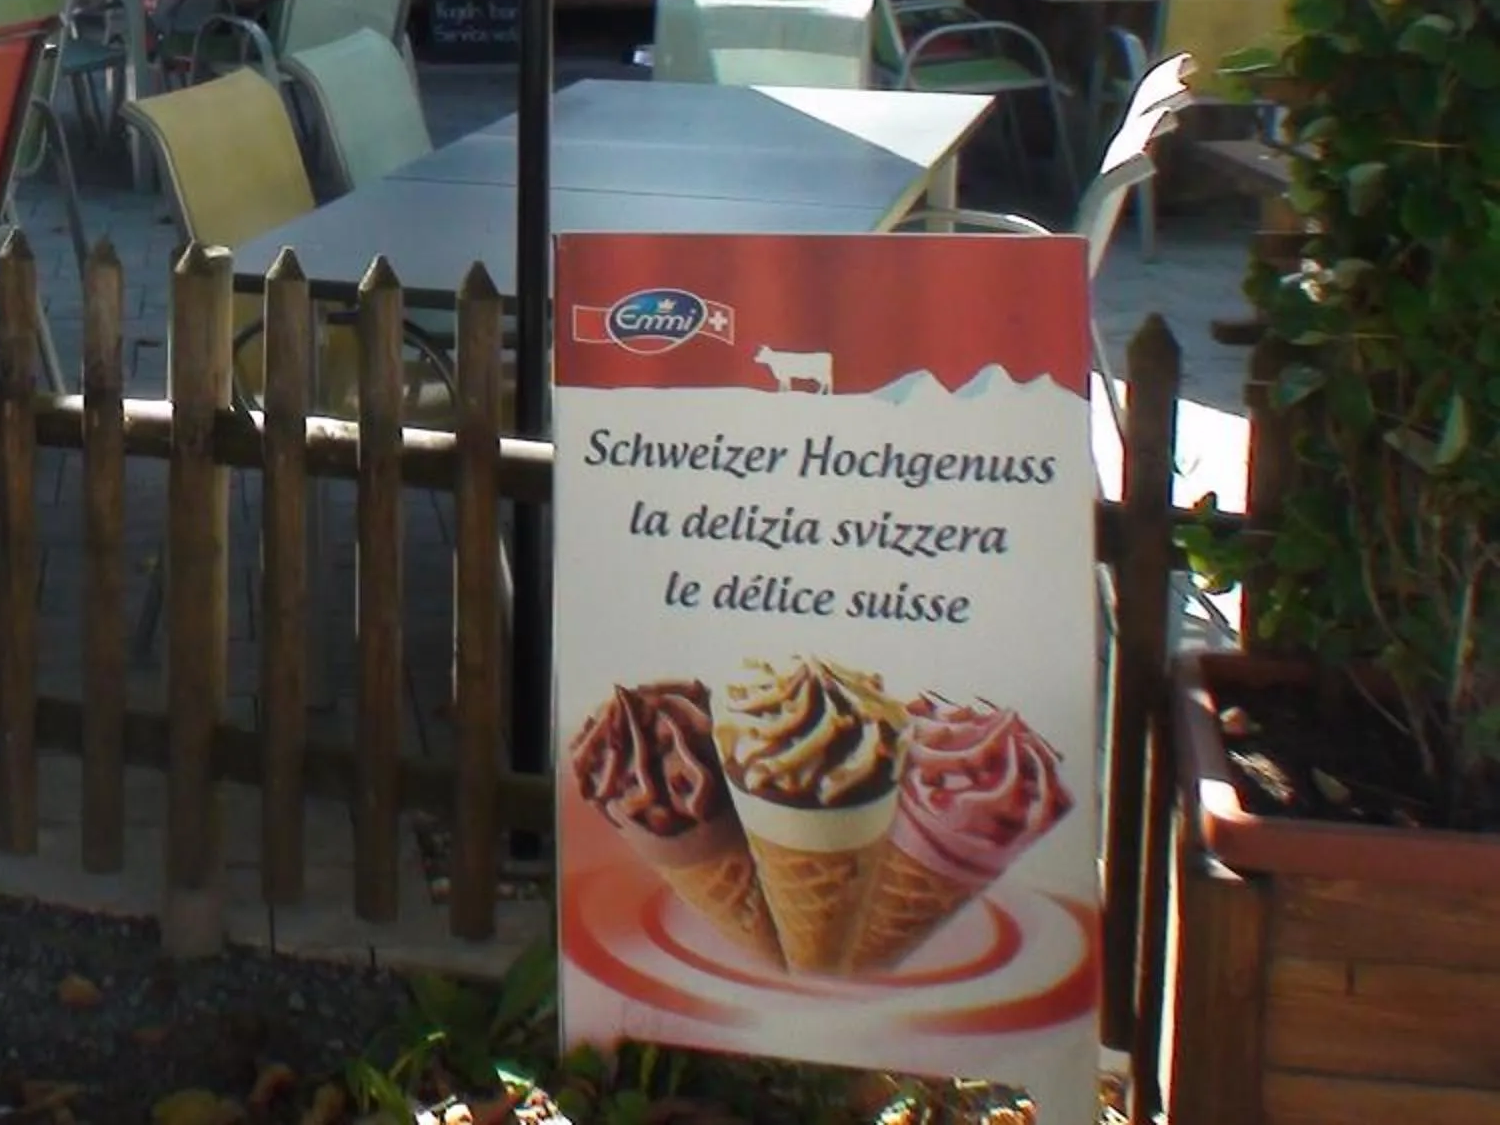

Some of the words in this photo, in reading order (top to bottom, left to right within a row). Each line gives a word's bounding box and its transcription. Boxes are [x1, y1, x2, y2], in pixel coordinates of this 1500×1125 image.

[615, 304, 697, 332] Emmi
[584, 428, 788, 478] Schweizer
[798, 435, 1057, 488] Hochgenuss
[628, 500, 668, 537] la
[681, 504, 820, 550] delizia
[831, 511, 1008, 557] svizzera
[664, 571, 701, 608] le
[712, 573, 835, 615] délice
[846, 582, 971, 623] suisse
